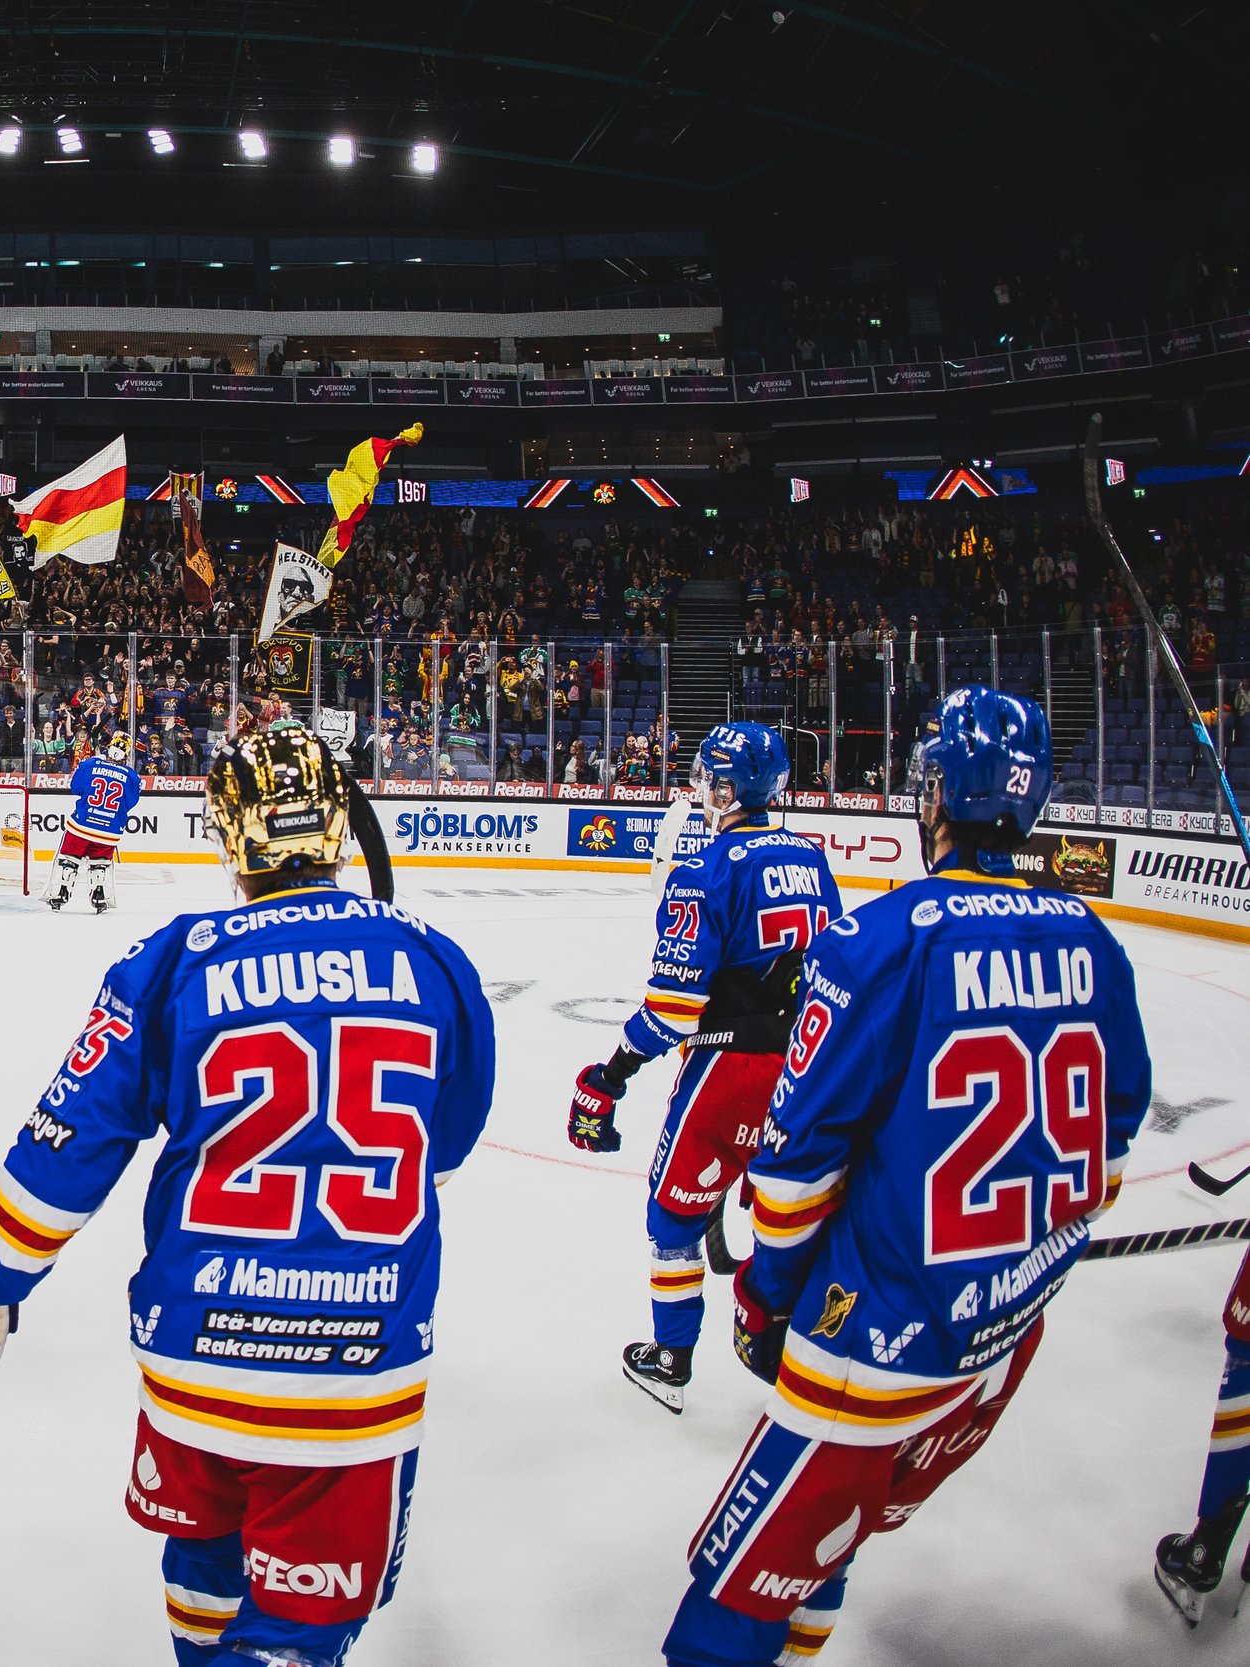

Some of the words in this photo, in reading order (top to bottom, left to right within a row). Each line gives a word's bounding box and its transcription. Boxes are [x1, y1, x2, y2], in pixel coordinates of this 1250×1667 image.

[130, 380, 163, 388] VEIKKAUS
[324, 384, 356, 392] VEIKKAUS
[474, 387, 505, 395] VEIKKAUS
[619, 384, 650, 392] VEIKKAUS
[397, 479, 427, 503] 1967
[278, 551, 332, 580] HELSINKI
[709, 726, 747, 747] ITIS
[91, 767, 128, 783] KARHUNEN
[152, 776, 206, 791] Redan
[1006, 765, 1032, 796] 29
[88, 777, 123, 811] 32
[383, 780, 432, 795] Redan
[438, 781, 489, 797] Redan
[494, 782, 545, 798] Redan
[668, 787, 704, 803] Reda
[833, 793, 878, 810] Redan
[273, 814, 319, 829] VEIKKAUS
[396, 806, 539, 852] SJÖBLOM'S
[626, 818, 653, 833] SEURAA
[421, 841, 531, 853] TANKSERVICE
[1012, 854, 1045, 872] KING
[762, 864, 822, 899] CURRY
[224, 899, 429, 937] CIRCULATION
[664, 900, 700, 942] 71
[205, 949, 422, 1017] KUUSLA
[953, 947, 1094, 1012] KALLIO
[639, 1006, 679, 1046] KATEPLAN
[786, 985, 833, 1079] 9
[180, 1016, 438, 1245] 25
[575, 1121, 602, 1133] DIMEX
[652, 1128, 672, 1182] HALTI
[924, 1022, 1107, 1265] 29
[229, 1258, 400, 1304] Mammutti
[207, 1313, 381, 1337] Itä-Vantaan
[195, 1338, 331, 1363] Rakennus
[342, 1344, 381, 1364] Oy
[702, 1469, 770, 1568] HALTI
[250, 1547, 362, 1600] FEON
